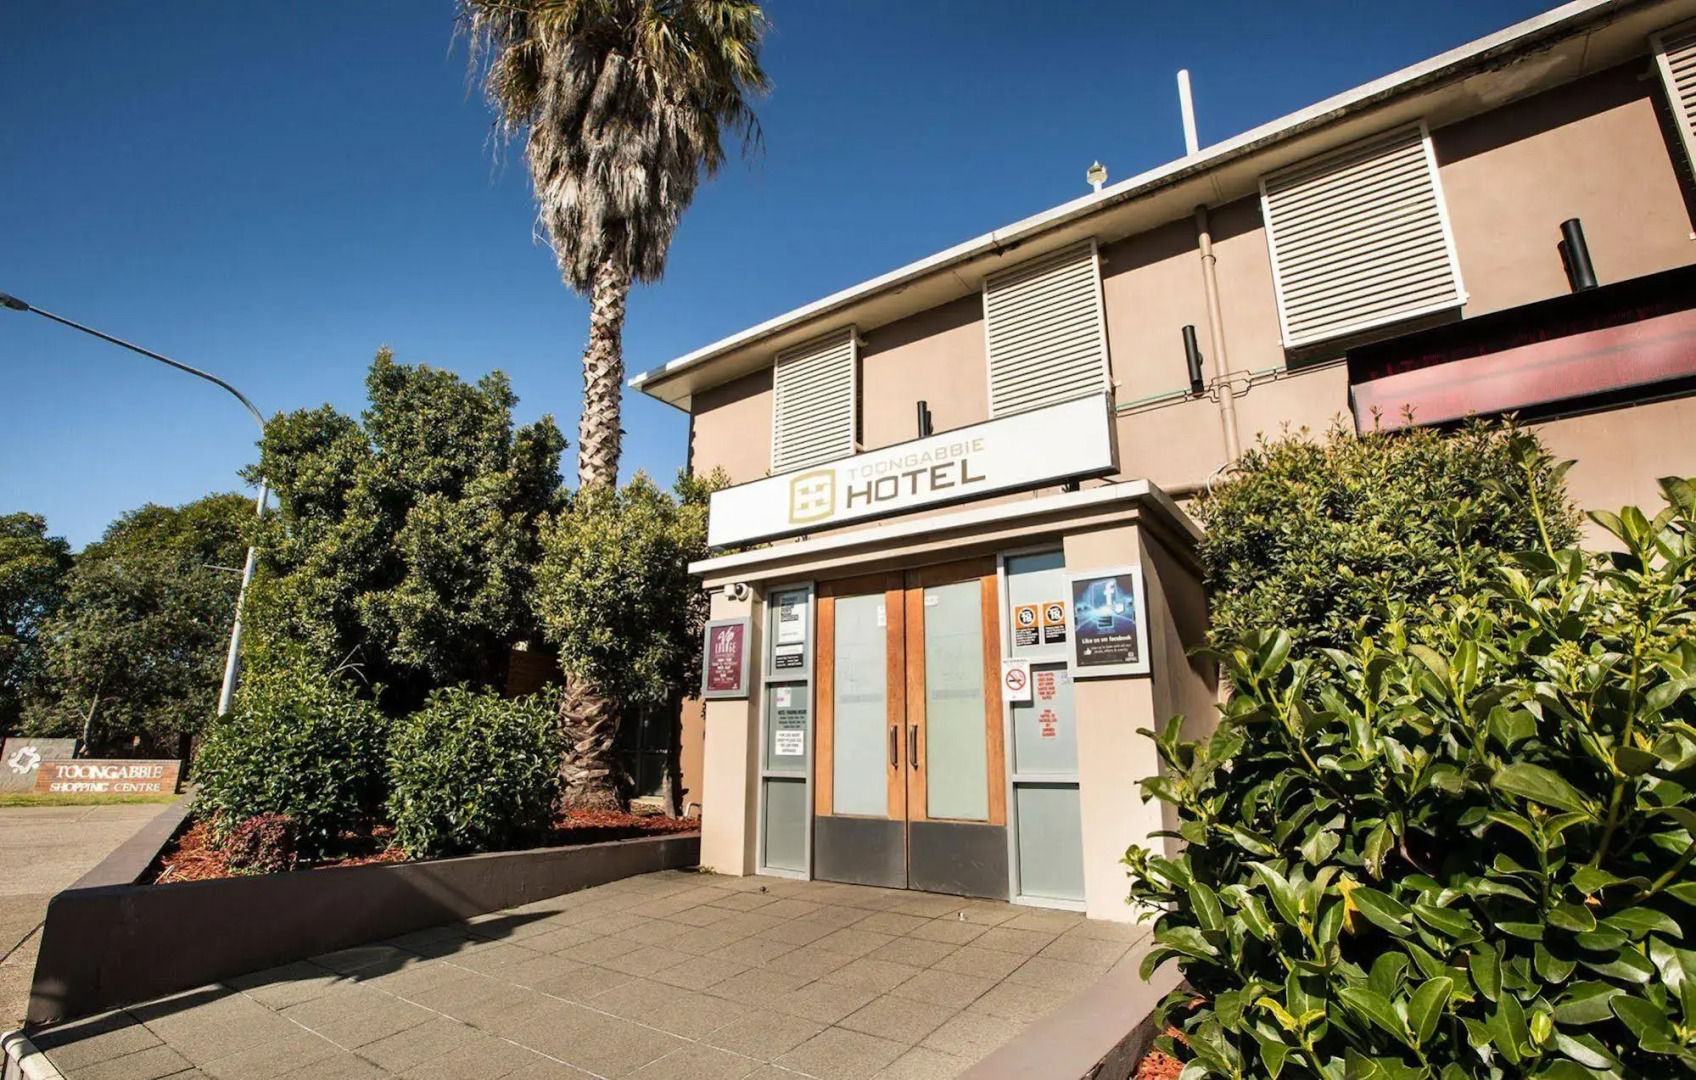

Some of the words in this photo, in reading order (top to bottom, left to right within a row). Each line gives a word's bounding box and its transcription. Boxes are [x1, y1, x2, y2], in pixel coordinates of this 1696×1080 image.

[846, 458, 986, 509] HOTEL
[56, 765, 163, 779] TOONGABBIE
[50, 782, 109, 793] SHOPPING
[114, 782, 161, 792] CENTRE
